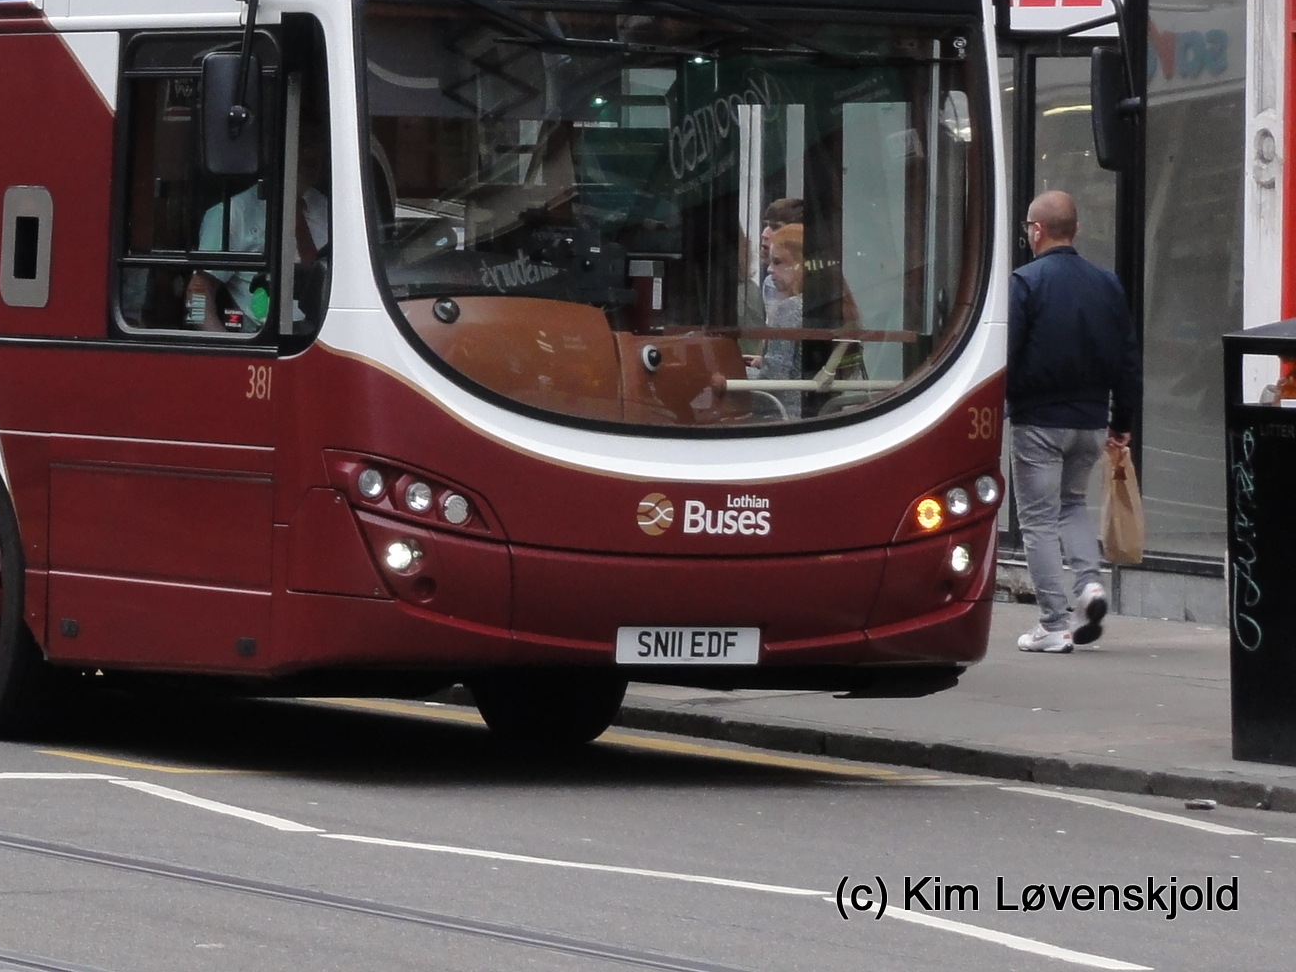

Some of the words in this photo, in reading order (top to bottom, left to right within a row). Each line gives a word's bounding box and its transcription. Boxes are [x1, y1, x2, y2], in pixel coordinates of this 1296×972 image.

[245, 364, 272, 400] 381
[967, 407, 997, 440] 381
[683, 500, 771, 535] Buses
[727, 494, 769, 508] Lothian
[637, 631, 682, 657] SN11
[690, 631, 738, 657] EDF
